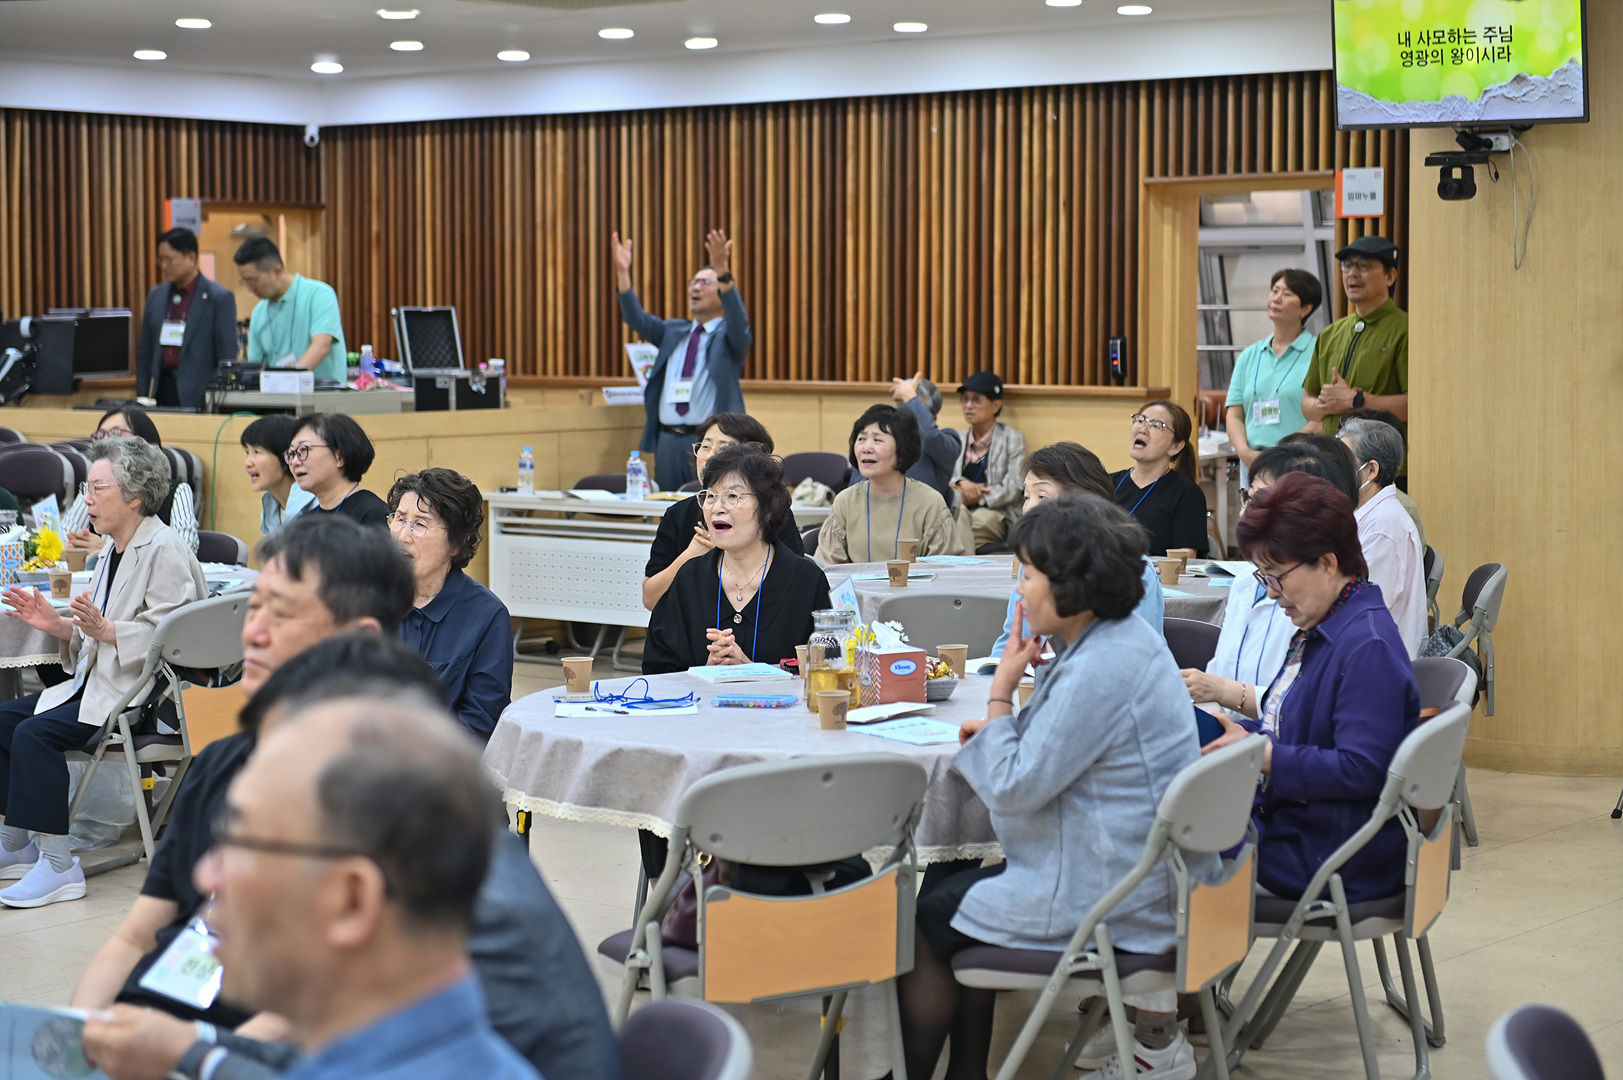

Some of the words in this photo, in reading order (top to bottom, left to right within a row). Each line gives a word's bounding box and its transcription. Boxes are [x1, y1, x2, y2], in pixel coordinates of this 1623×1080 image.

[1398, 30, 1411, 48] 내
[1417, 28, 1477, 47] 사모하는
[1483, 25, 1512, 43] 주님
[1400, 48, 1443, 68] 영광의
[1451, 45, 1511, 65] 왕이시라
